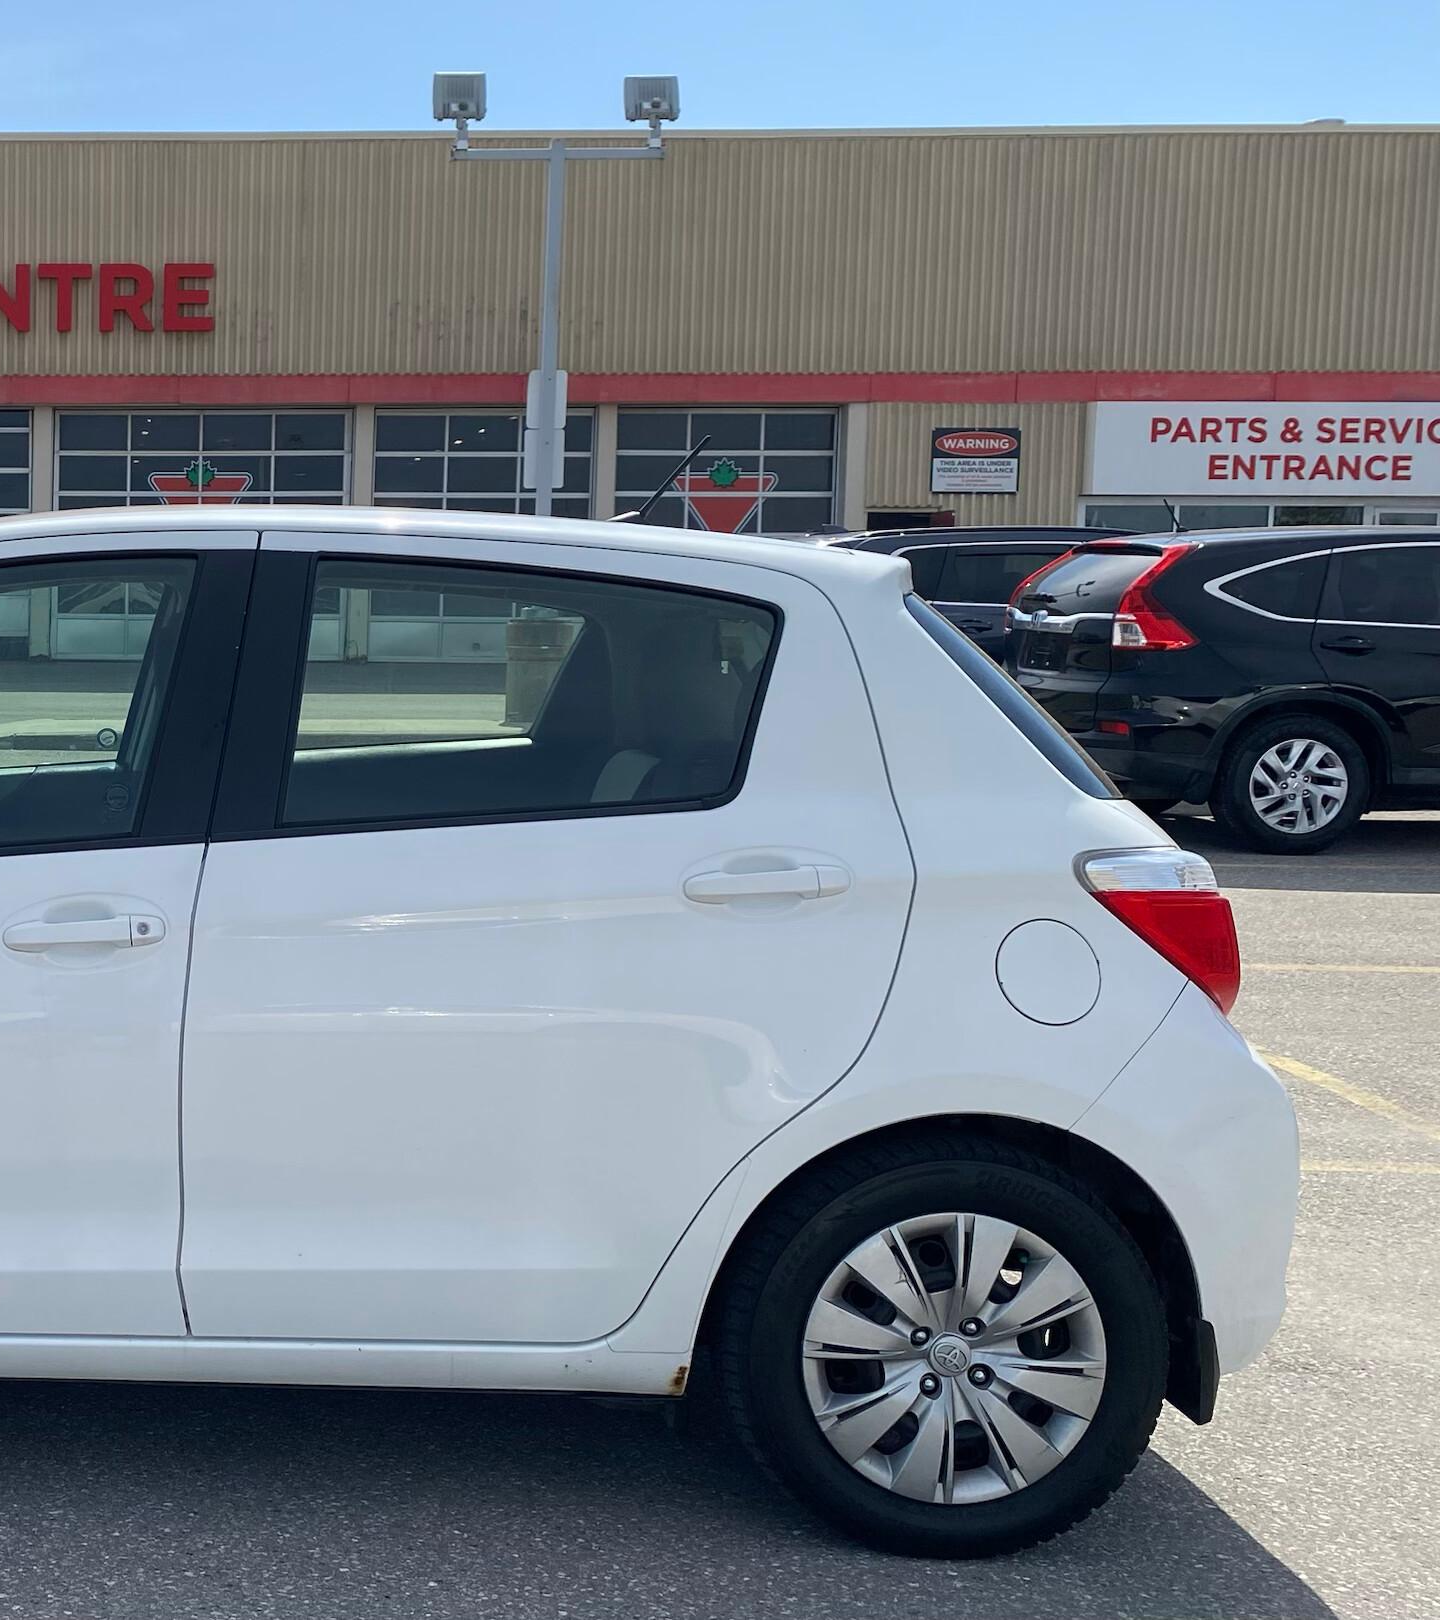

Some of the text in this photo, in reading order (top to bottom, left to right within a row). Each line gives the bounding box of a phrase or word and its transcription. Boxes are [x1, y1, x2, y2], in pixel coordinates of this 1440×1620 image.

[1150, 417, 1268, 443] PARTS
[1279, 418, 1303, 443] &
[943, 439, 1010, 449] WARNING
[1208, 455, 1413, 481] ENTRANCE
